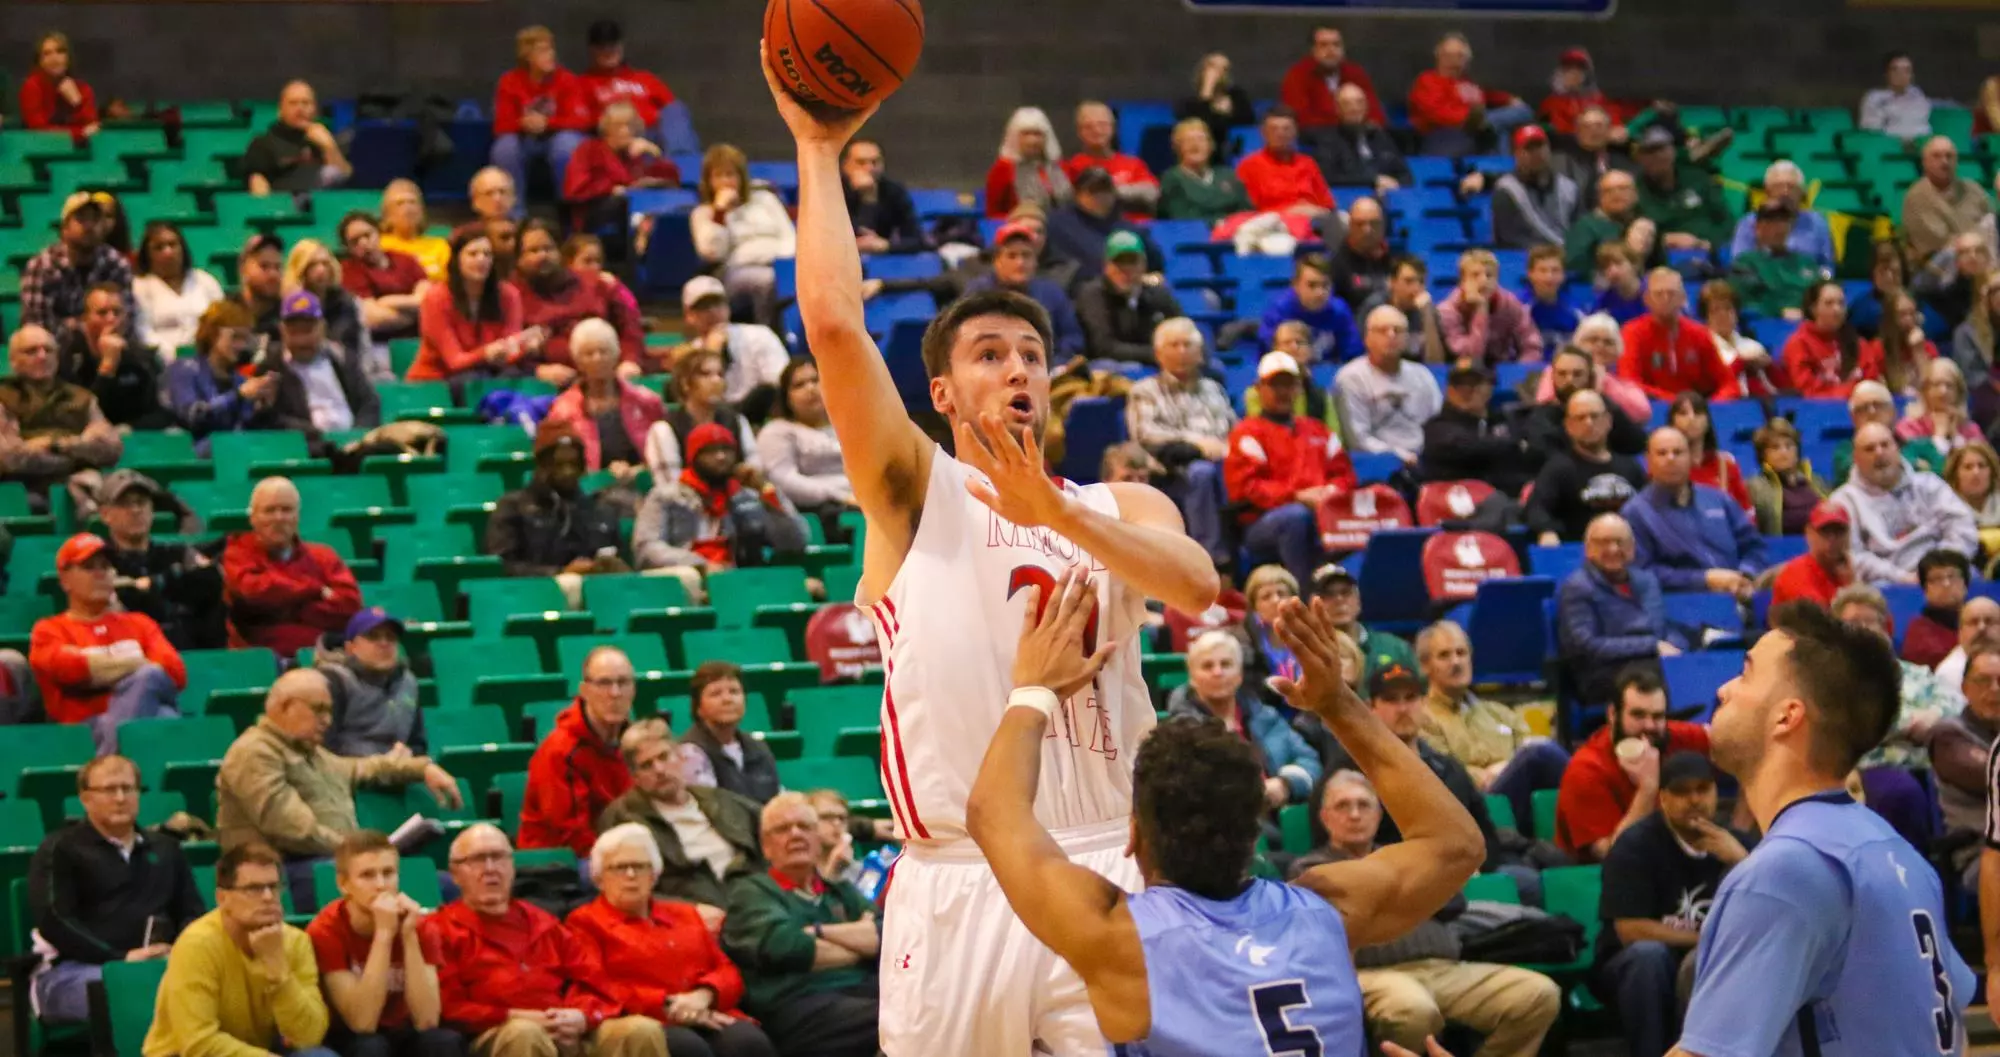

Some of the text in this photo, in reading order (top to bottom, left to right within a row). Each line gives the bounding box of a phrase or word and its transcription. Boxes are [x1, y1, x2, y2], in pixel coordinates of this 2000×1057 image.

[813, 41, 877, 97] NCAA
[1248, 978, 1324, 1057] 5
[1911, 908, 1954, 1055] 3
